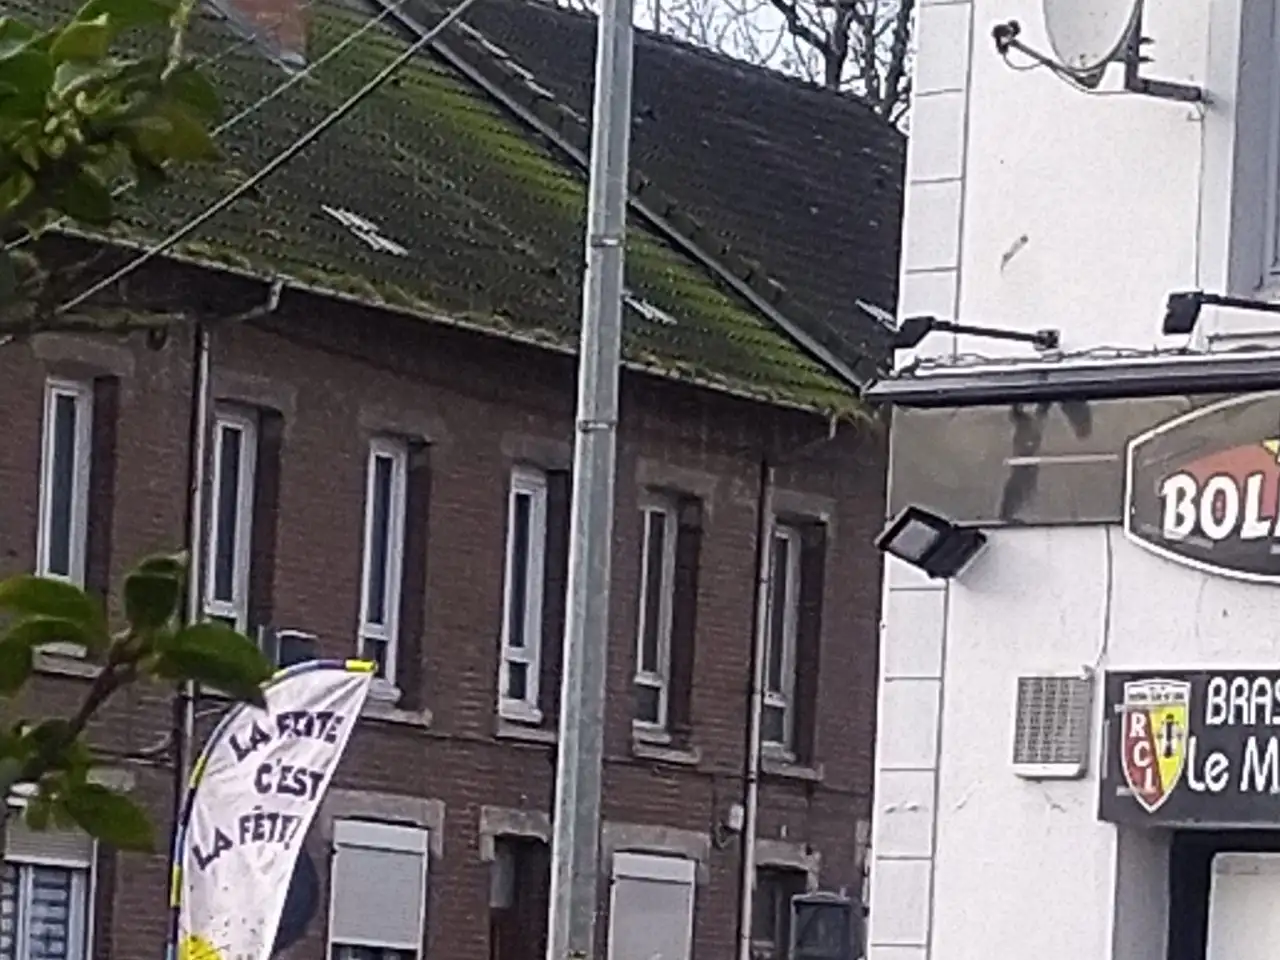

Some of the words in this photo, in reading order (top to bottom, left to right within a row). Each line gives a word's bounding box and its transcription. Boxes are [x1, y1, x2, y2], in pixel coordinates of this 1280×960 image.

[229, 719, 272, 763] LA
[1129, 711, 1156, 794] RCL
[1187, 735, 1230, 792] Le
[253, 757, 325, 801] C'EST
[191, 826, 234, 871] LA
